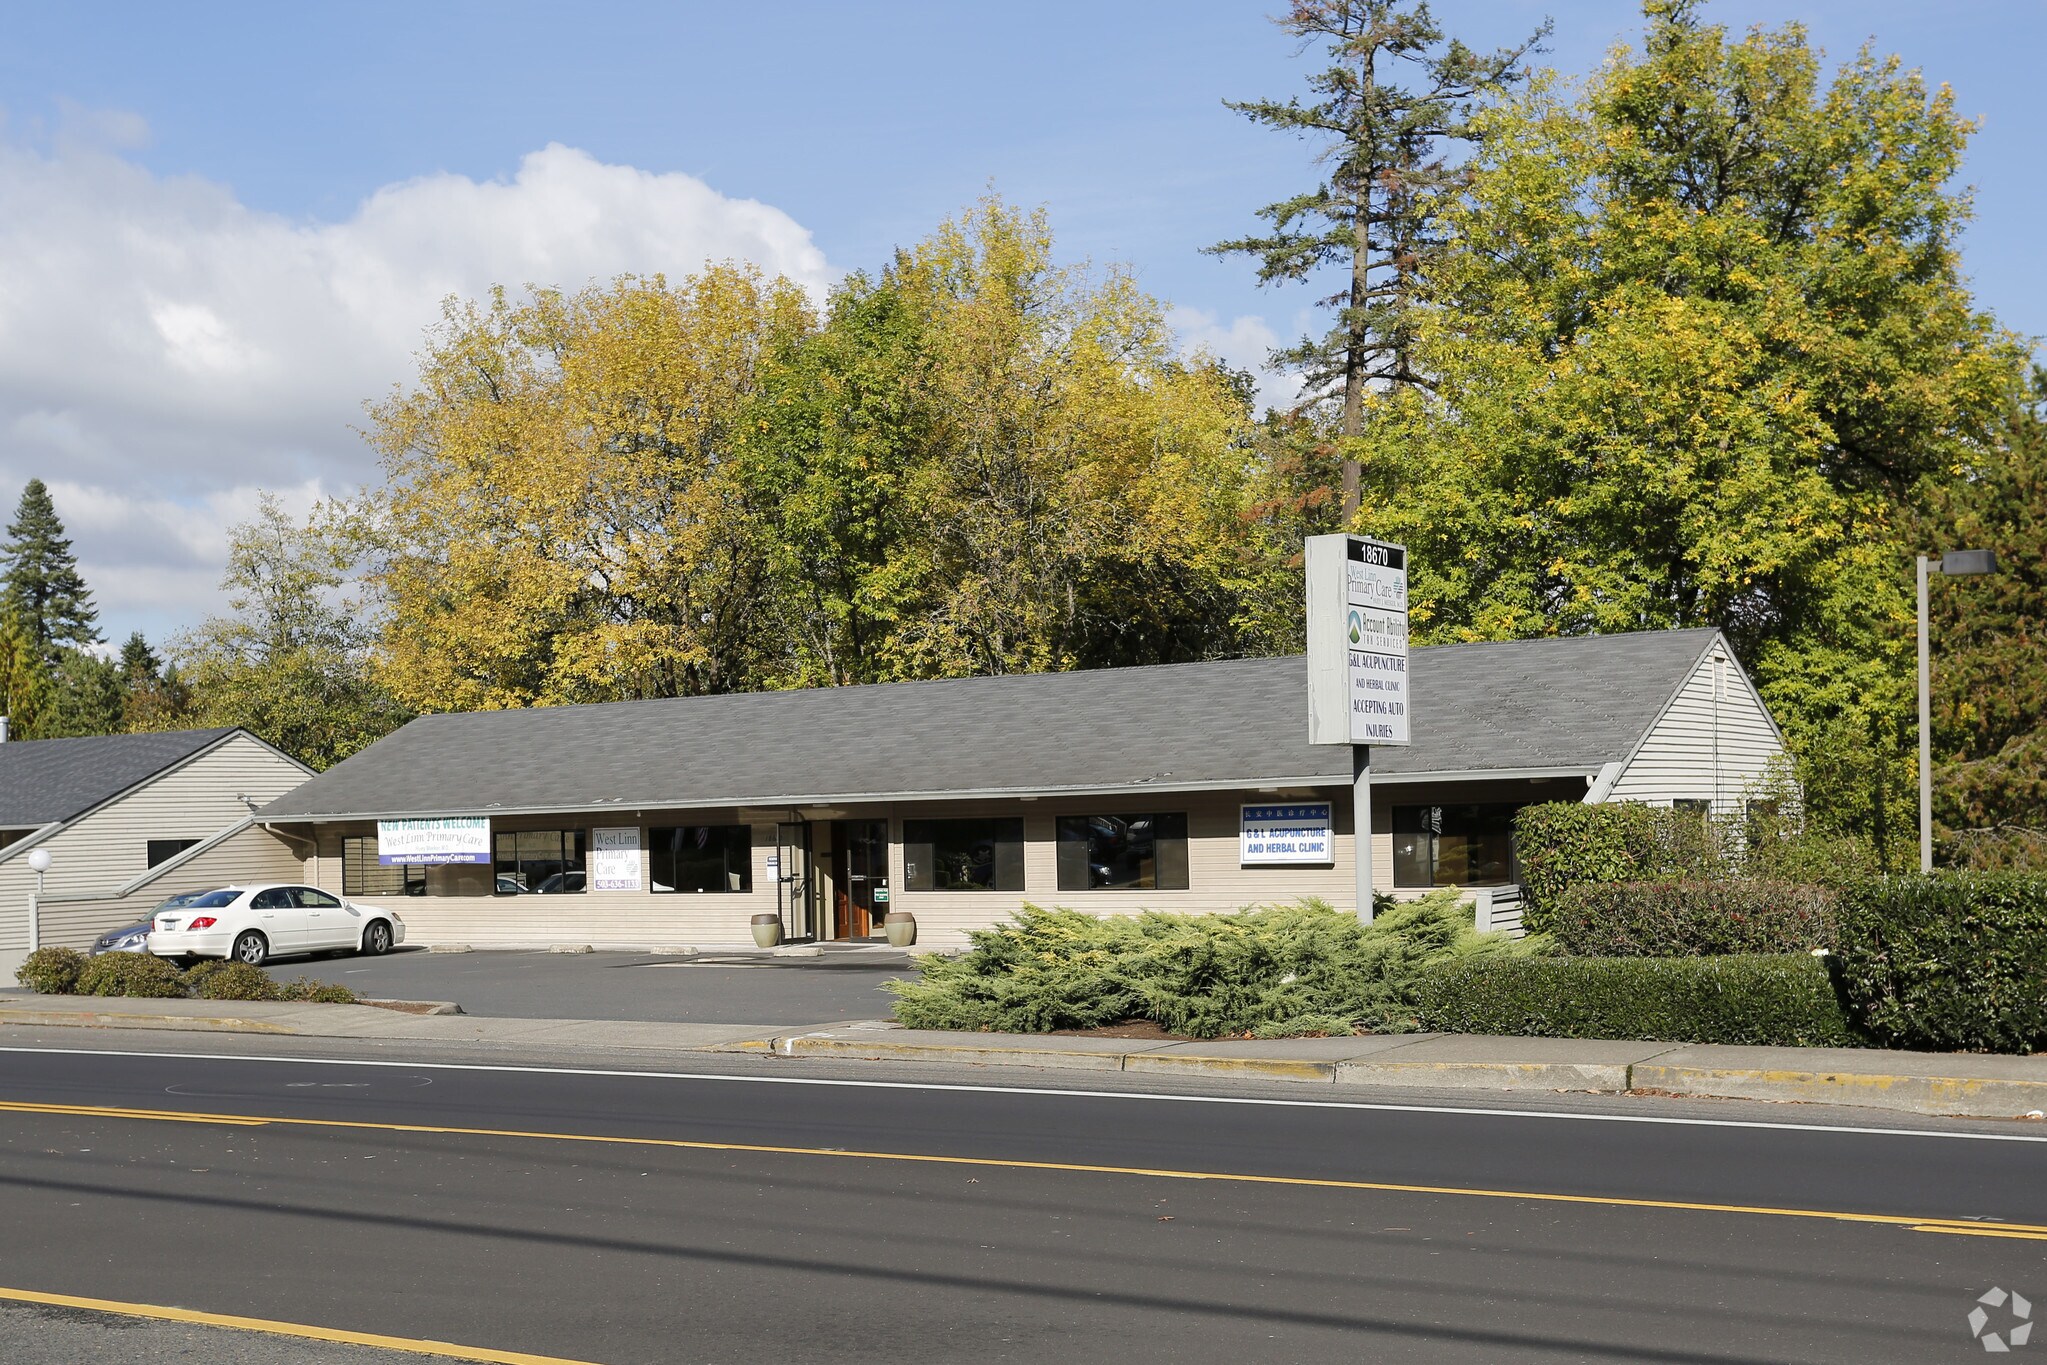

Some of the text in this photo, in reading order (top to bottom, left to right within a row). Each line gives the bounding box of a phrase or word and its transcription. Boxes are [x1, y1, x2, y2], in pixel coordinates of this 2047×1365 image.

[1361, 544, 1388, 566] 18670
[1350, 565, 1377, 582] West Linn
[1348, 574, 1392, 599] Primary Care
[1362, 612, 1385, 634] Account
[1363, 634, 1403, 649] TAX SERVICES
[1349, 653, 1405, 672] G&L ACUPUNCTURE
[1356, 678, 1400, 692] AND HERBAL CLINIC
[1353, 699, 1404, 716] ACCEPTING AUTO
[1366, 723, 1393, 739] INJURIES
[381, 816, 486, 831] NEW PATIENTS WELCOME
[385, 831, 483, 848] West Linn Primary Care
[596, 832, 637, 845] West Linn
[1269, 826, 1326, 838] ACUPUNCTURE
[596, 847, 629, 863] Primary
[1247, 842, 1325, 853] AND HERBAL CLINIC
[391, 853, 476, 863] www.WestLinnPrimaryCare.com
[596, 862, 616, 875] Care
